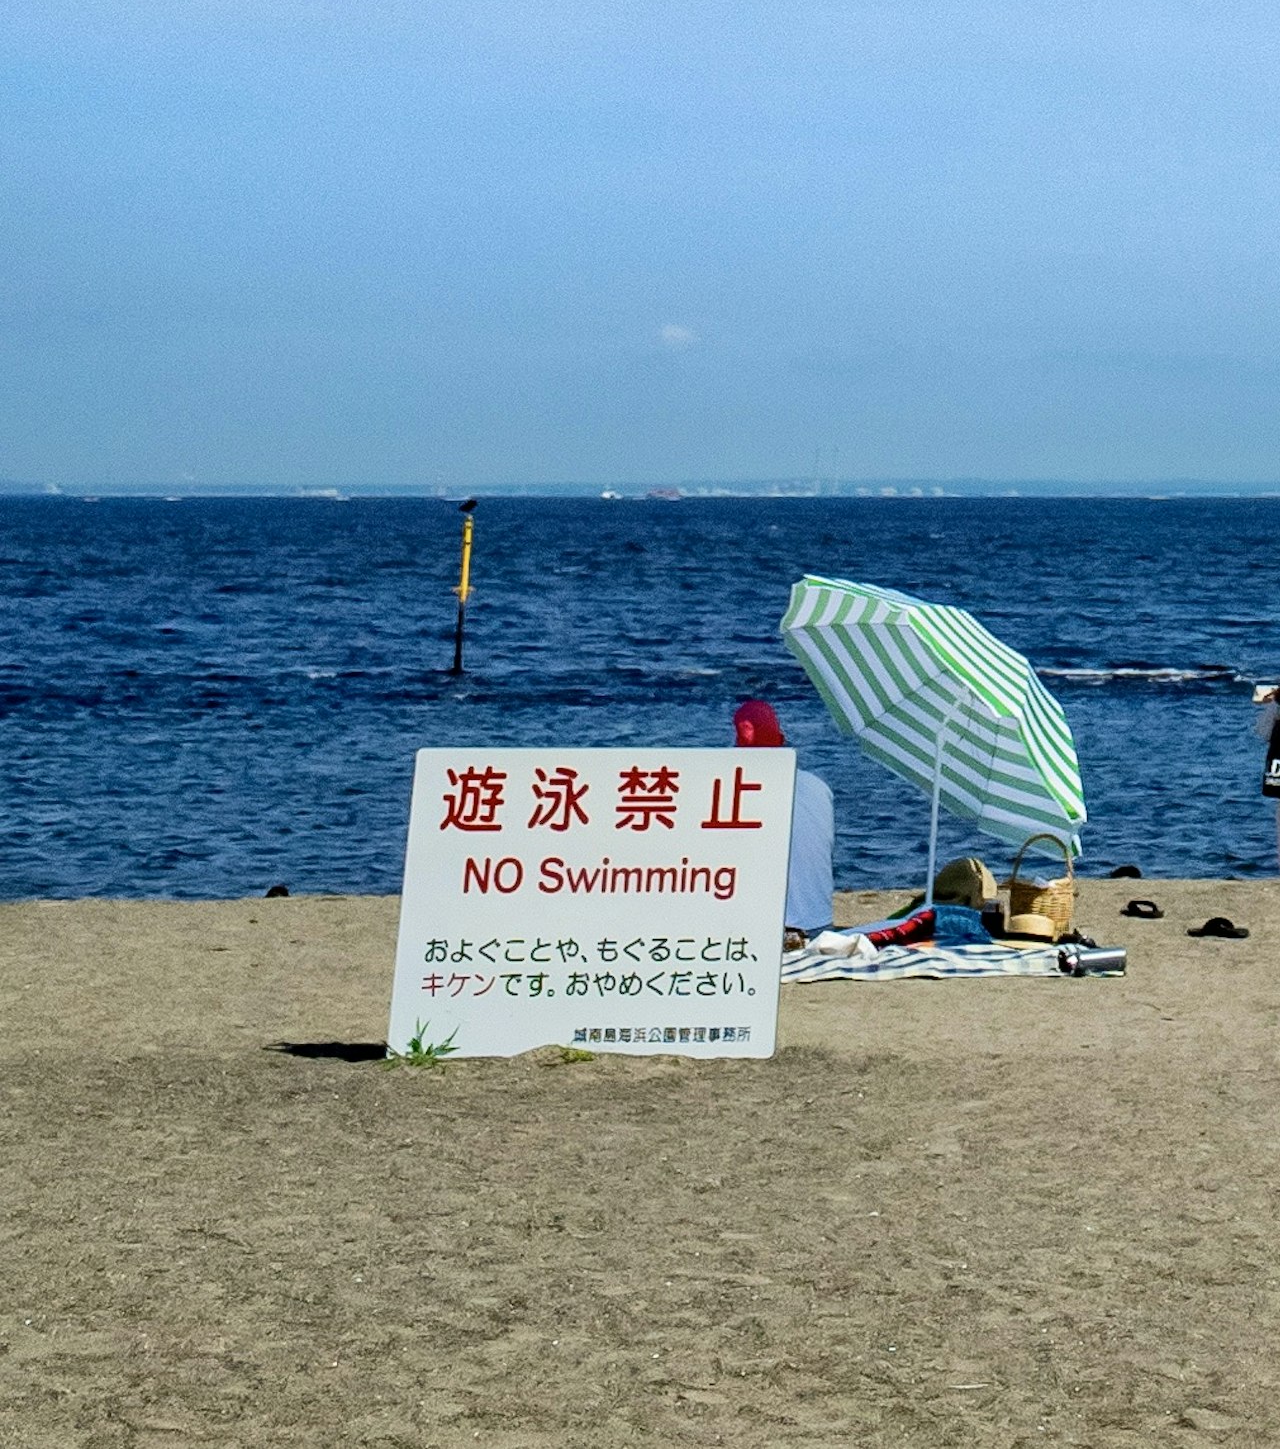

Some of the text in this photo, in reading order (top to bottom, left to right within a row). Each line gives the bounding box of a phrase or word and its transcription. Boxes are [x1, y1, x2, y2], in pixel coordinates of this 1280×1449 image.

[440, 765, 763, 832] 遊泳禁止
[463, 857, 737, 900] NO Swimming
[572, 1025, 752, 1044] 城南島海浜公園管理事務所
